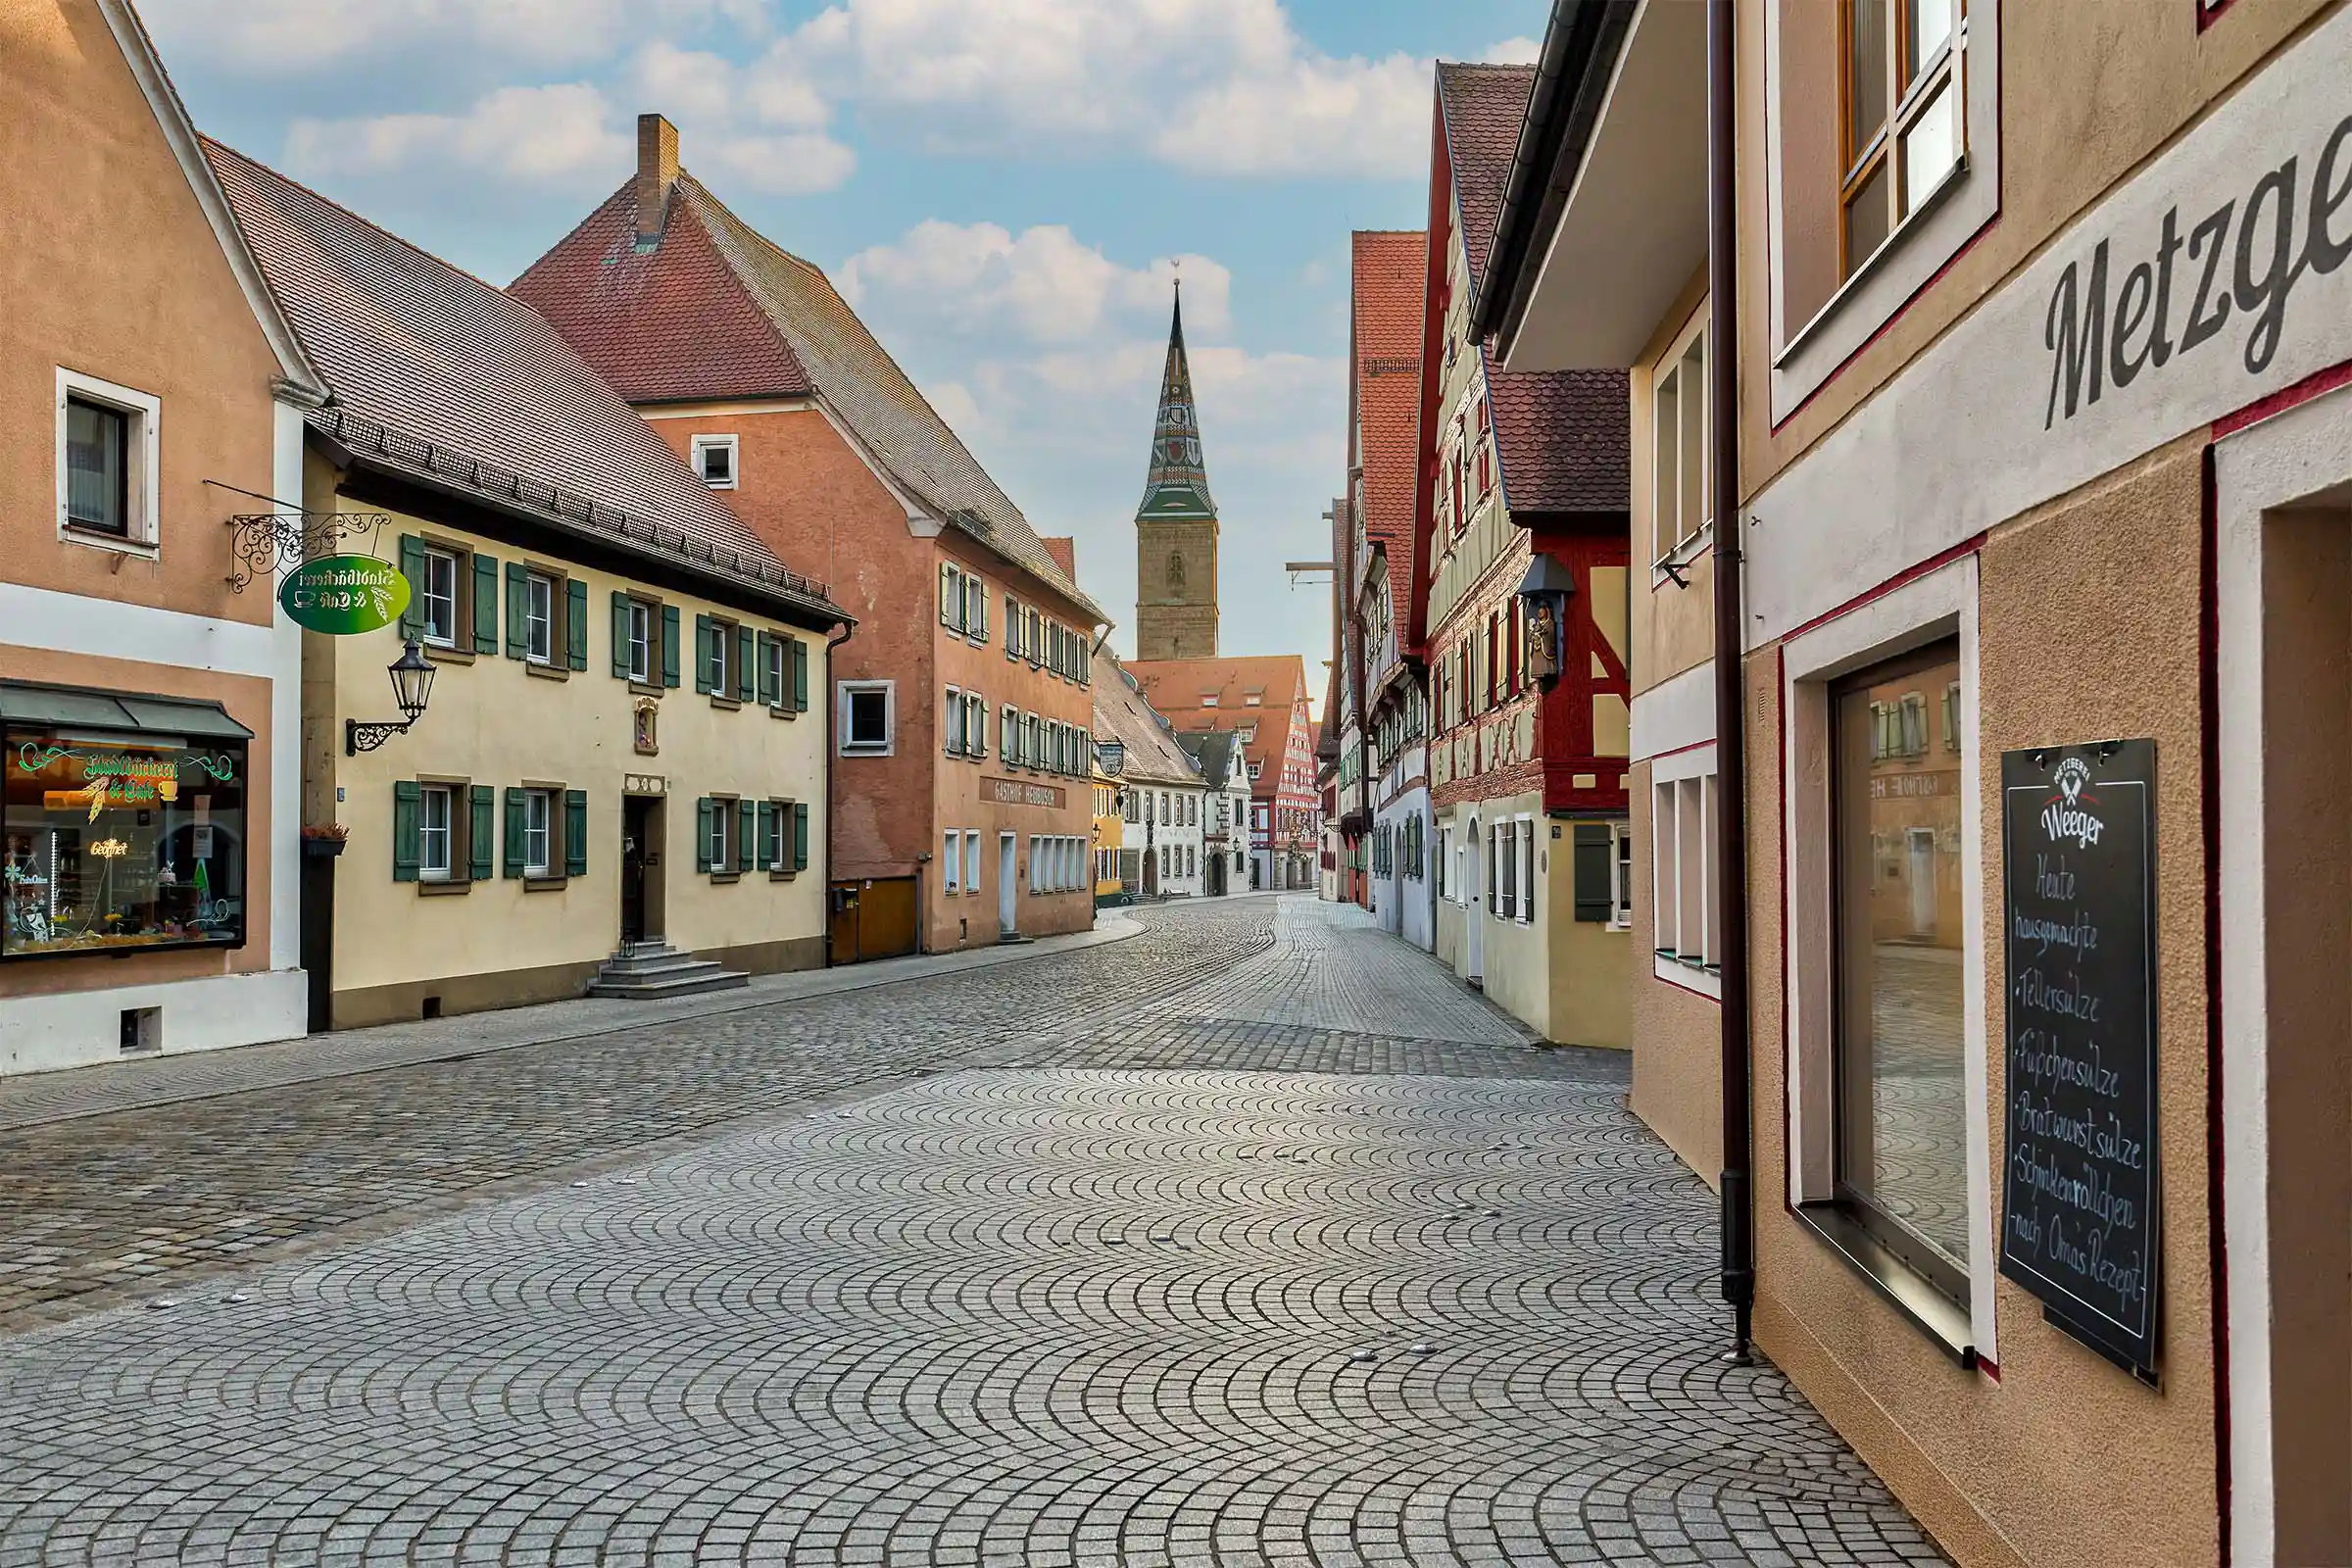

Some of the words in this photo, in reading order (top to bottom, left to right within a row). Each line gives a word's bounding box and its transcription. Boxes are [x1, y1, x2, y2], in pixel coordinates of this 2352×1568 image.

[109, 778, 122, 799] &
[995, 781, 1021, 802] GASTHOF
[2054, 758, 2090, 785] METZGEREI
[2041, 802, 2104, 850] Weeger
[2035, 853, 2076, 900] Heute
[2015, 906, 2097, 962] hausgemachte
[2020, 967, 2100, 1021] Tellersülze
